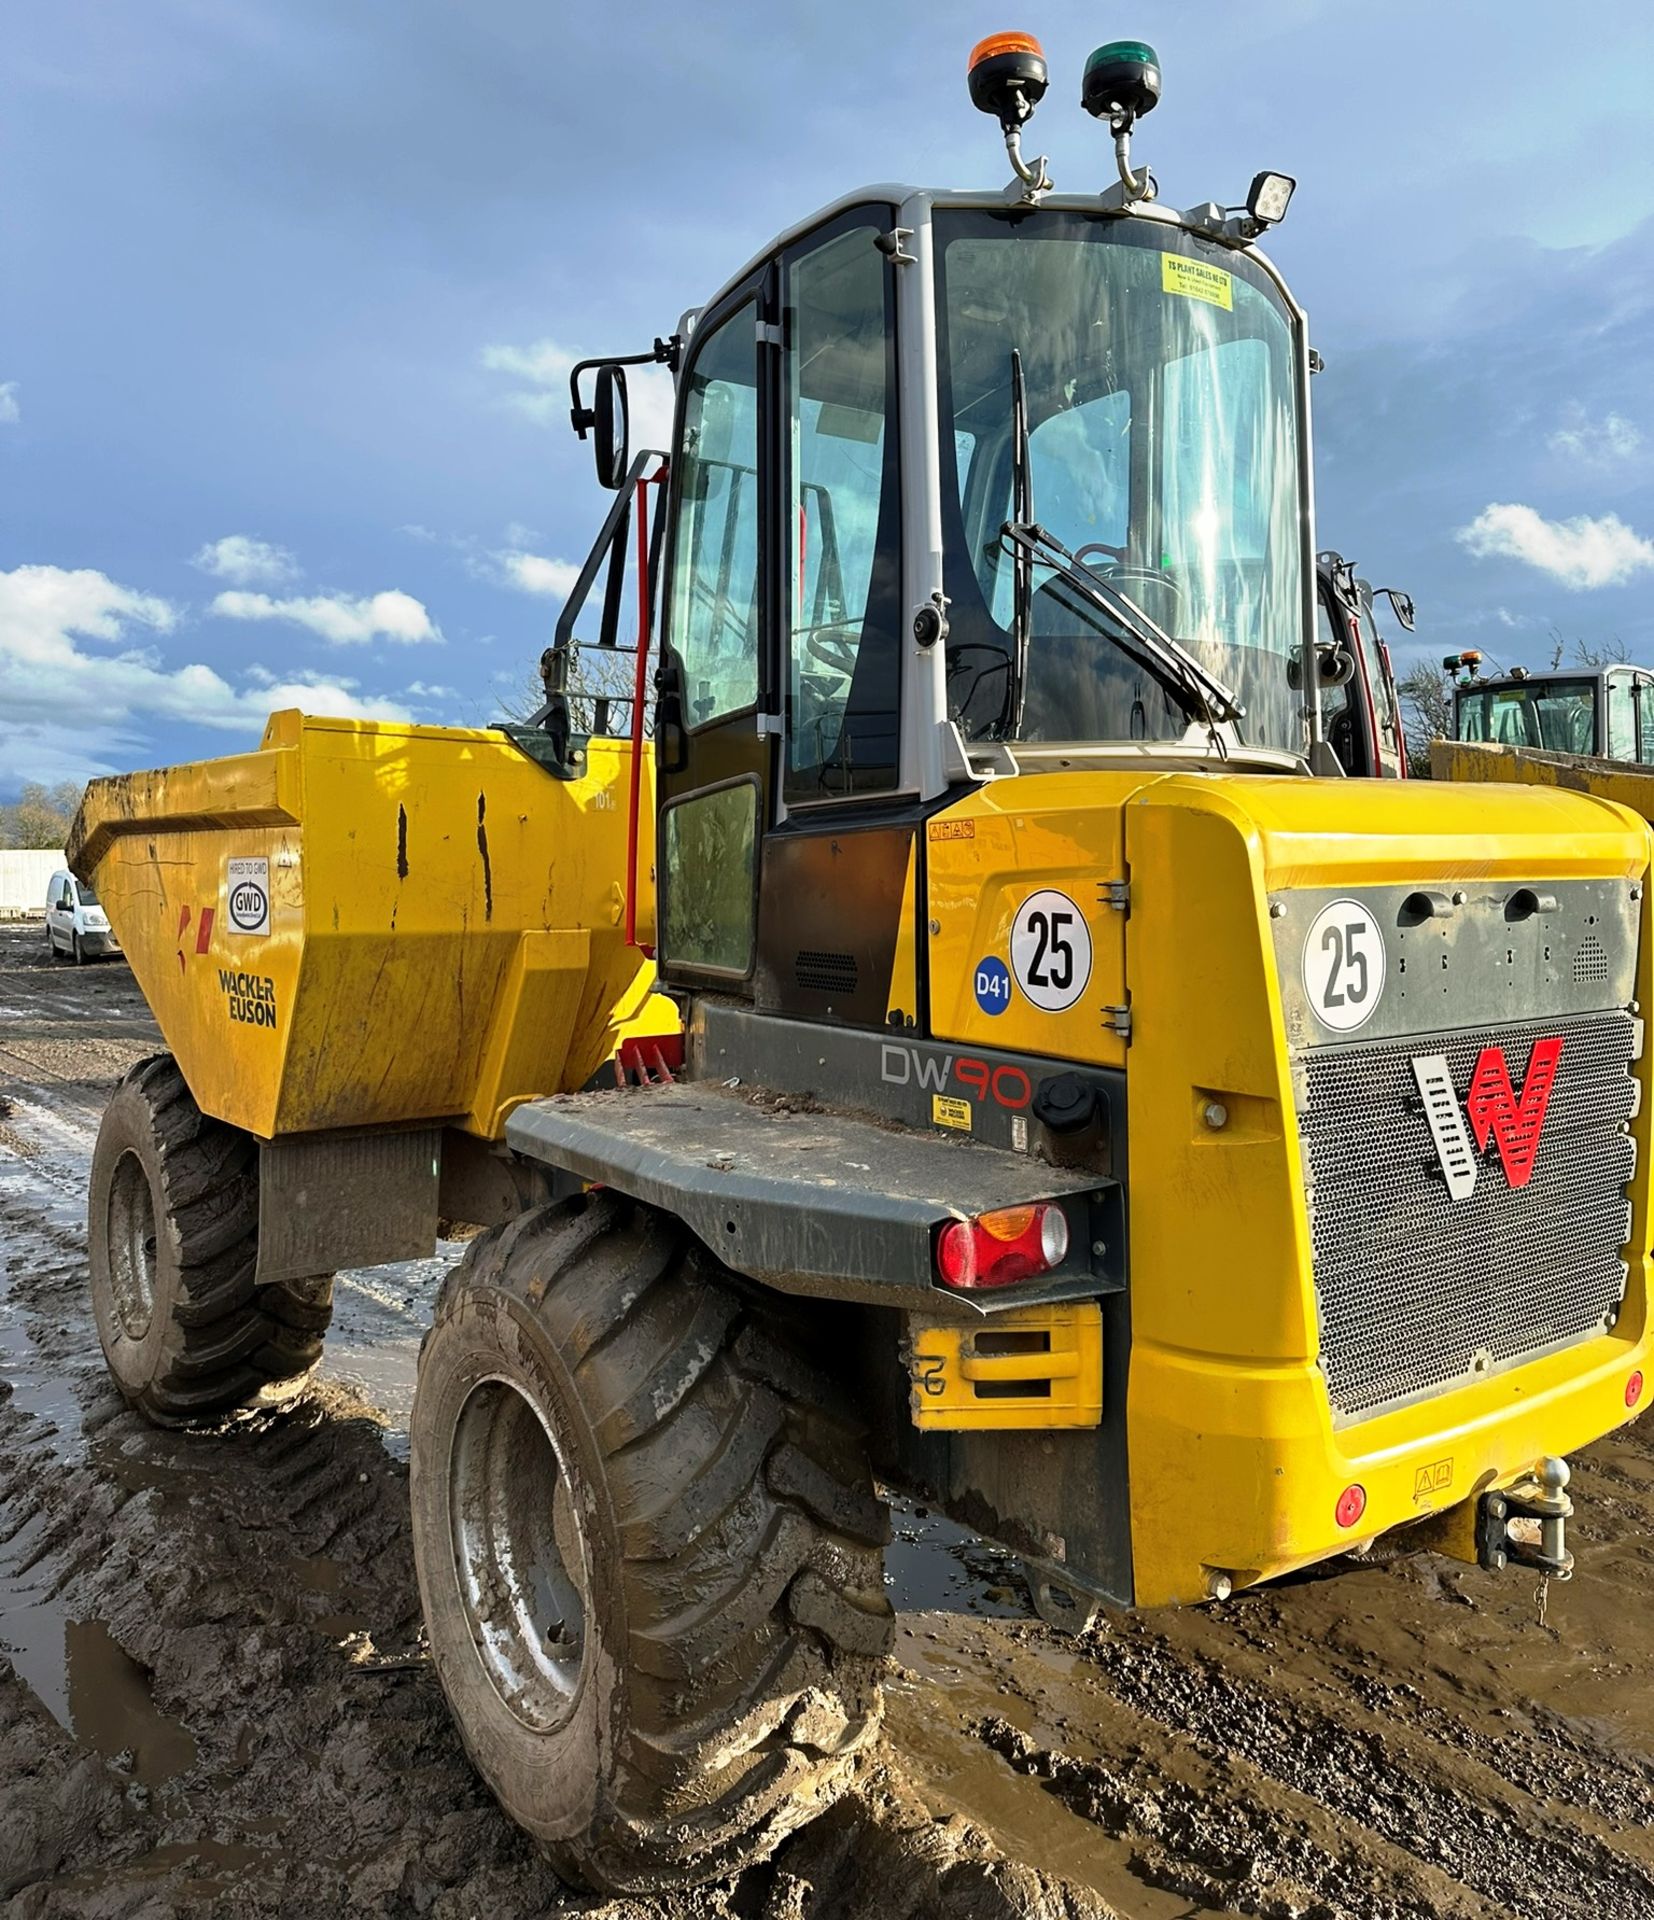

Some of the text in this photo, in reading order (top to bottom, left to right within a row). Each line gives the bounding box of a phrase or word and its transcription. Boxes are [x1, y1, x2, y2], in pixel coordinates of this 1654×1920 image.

[1168, 260, 1177, 271] TS
[1177, 263, 1195, 275] PLANT
[1195, 268, 1212, 281] SALES
[229, 862, 267, 875] HIRED TO GWD
[235, 892, 261, 912] GWD
[1027, 911, 1073, 989] 25
[1321, 922, 1368, 1008] 25
[218, 969, 276, 1003] WACKER
[976, 972, 1009, 1000] D41
[881, 1044, 1032, 1109] DW90
